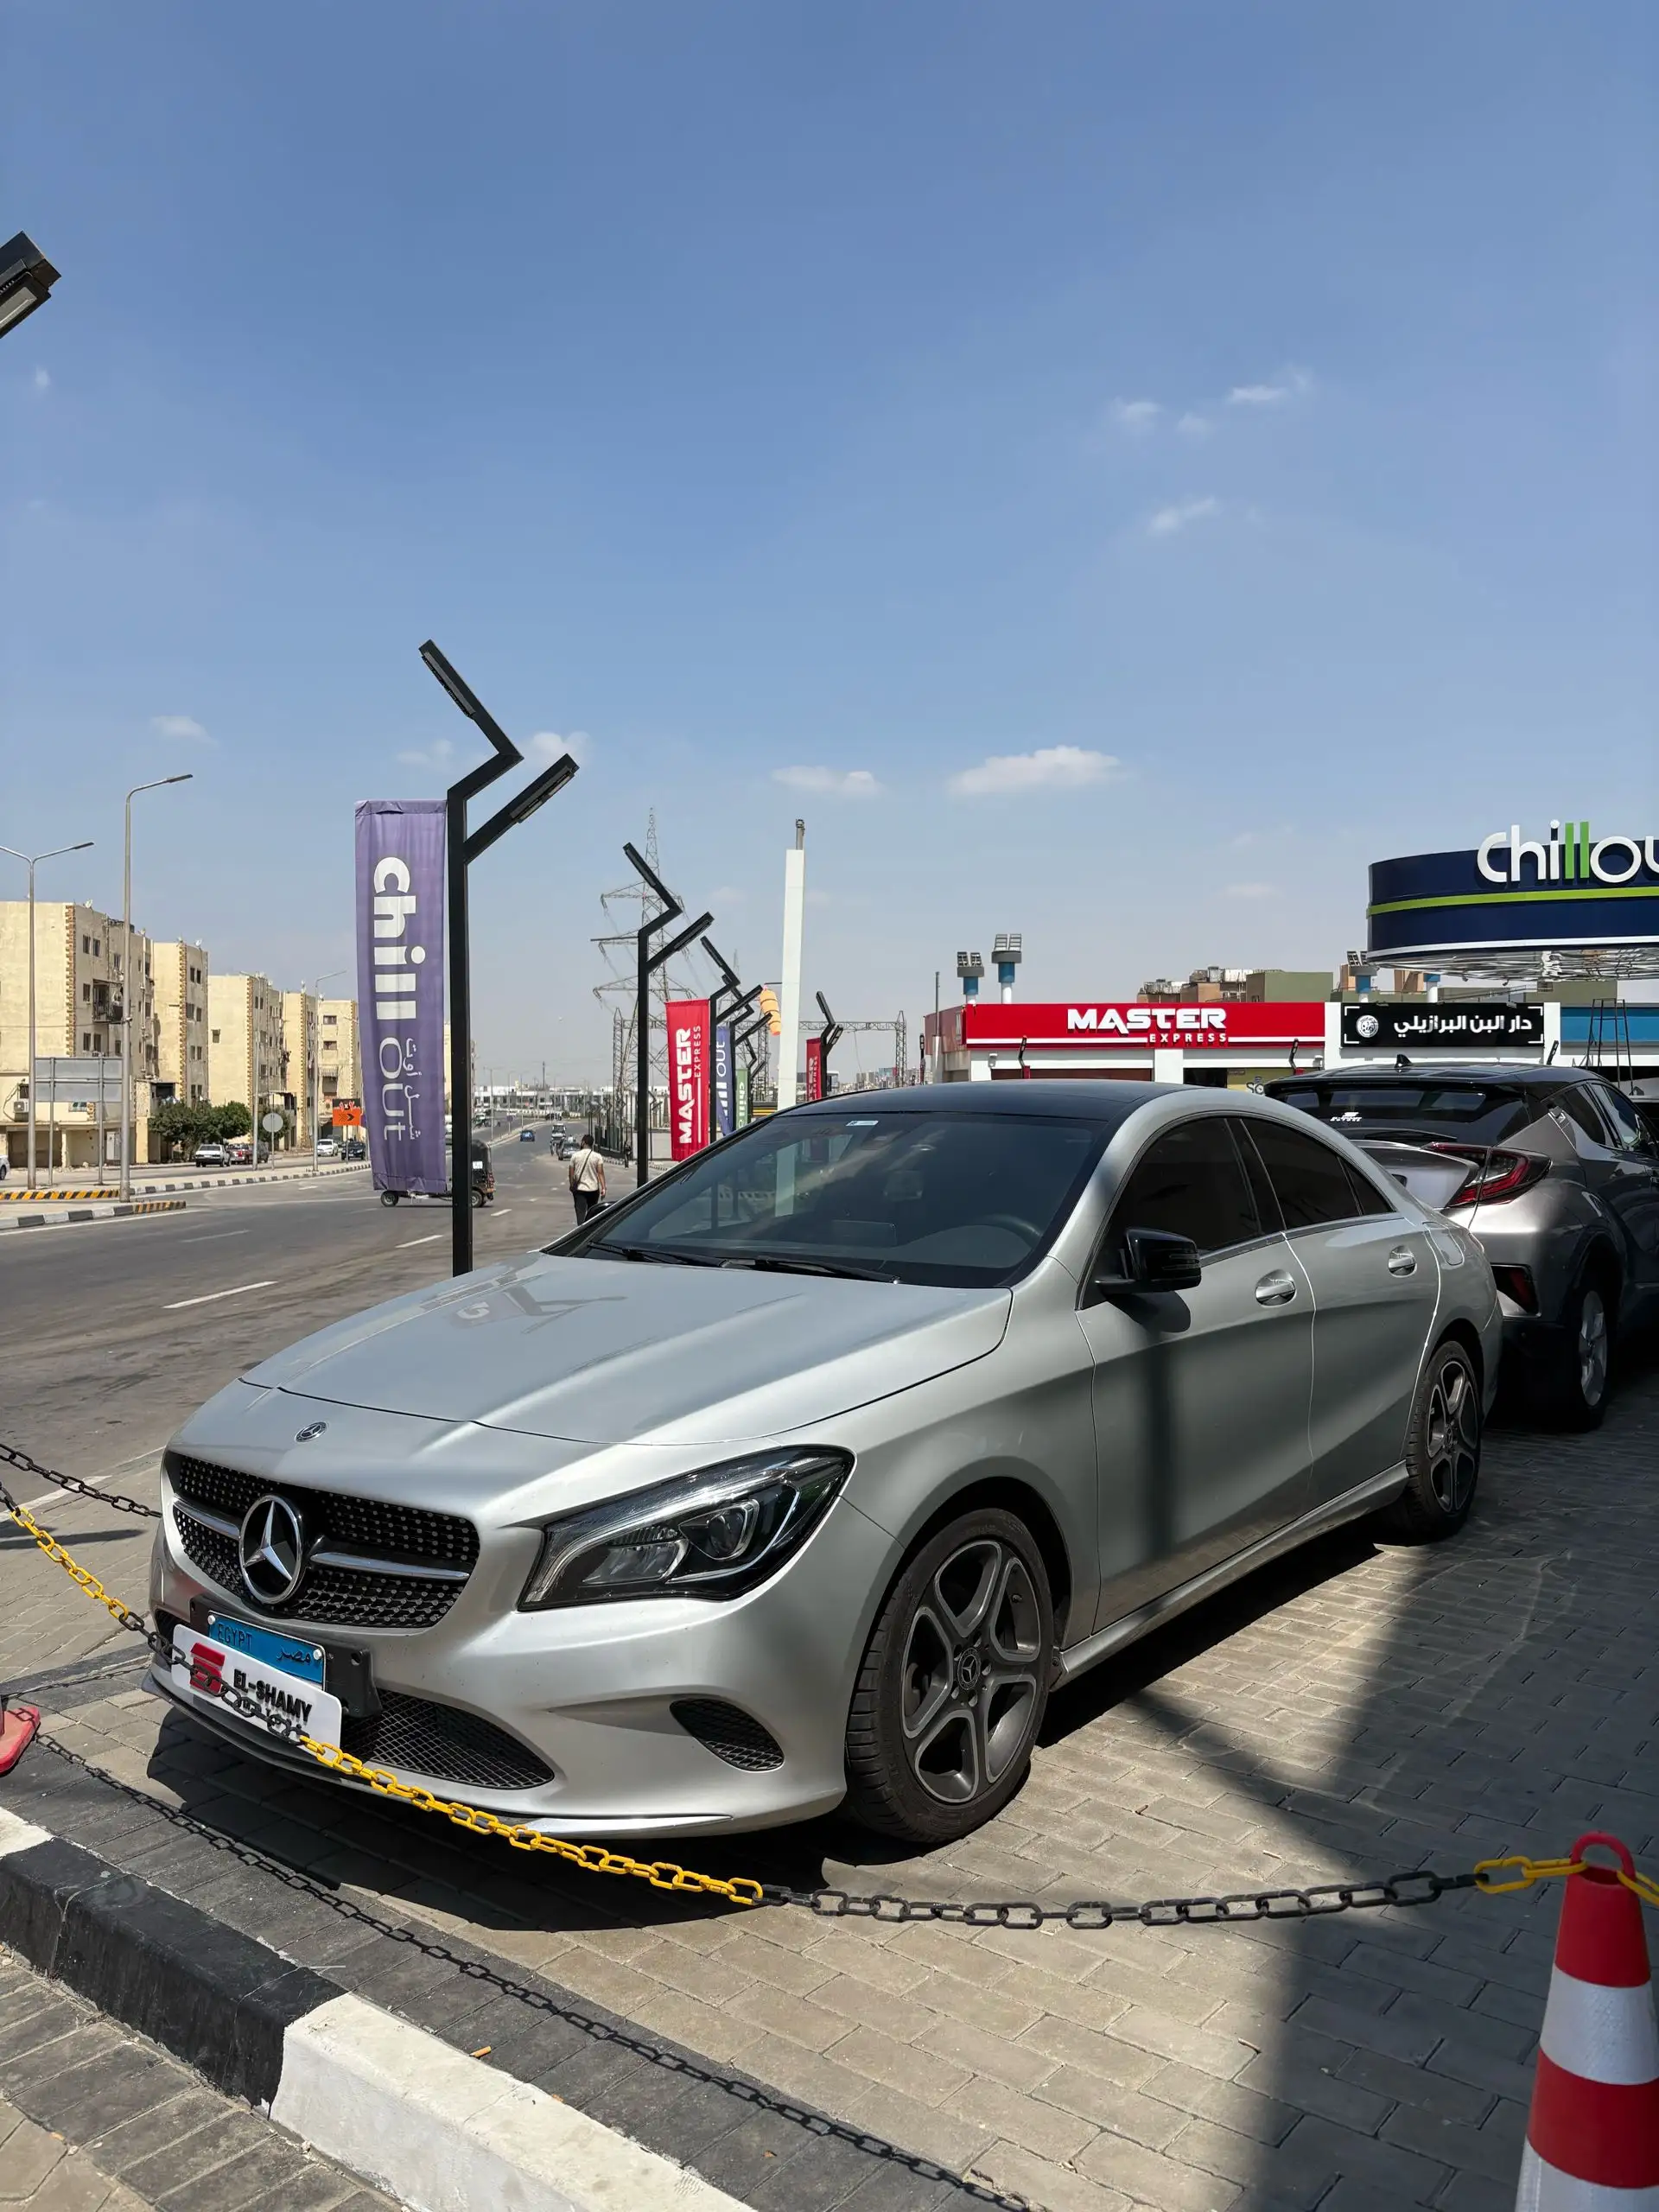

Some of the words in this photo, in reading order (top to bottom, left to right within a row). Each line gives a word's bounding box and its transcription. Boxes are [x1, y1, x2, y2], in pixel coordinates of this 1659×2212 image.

[373, 856, 426, 1020] chill
[1067, 1007, 1227, 1034] MASTER
[1394, 1014, 1466, 1038] البرازيلي
[1470, 1014, 1505, 1033] البن
[1508, 1014, 1533, 1033] دار
[693, 1025, 702, 1078] EXPRESS
[1149, 1033, 1227, 1044] EXPRESS
[676, 1027, 695, 1144] MASTER
[217, 1623, 252, 1650] EGYPT
[276, 1645, 312, 1664] مصر
[233, 1669, 313, 1723] EL-SHAMY
